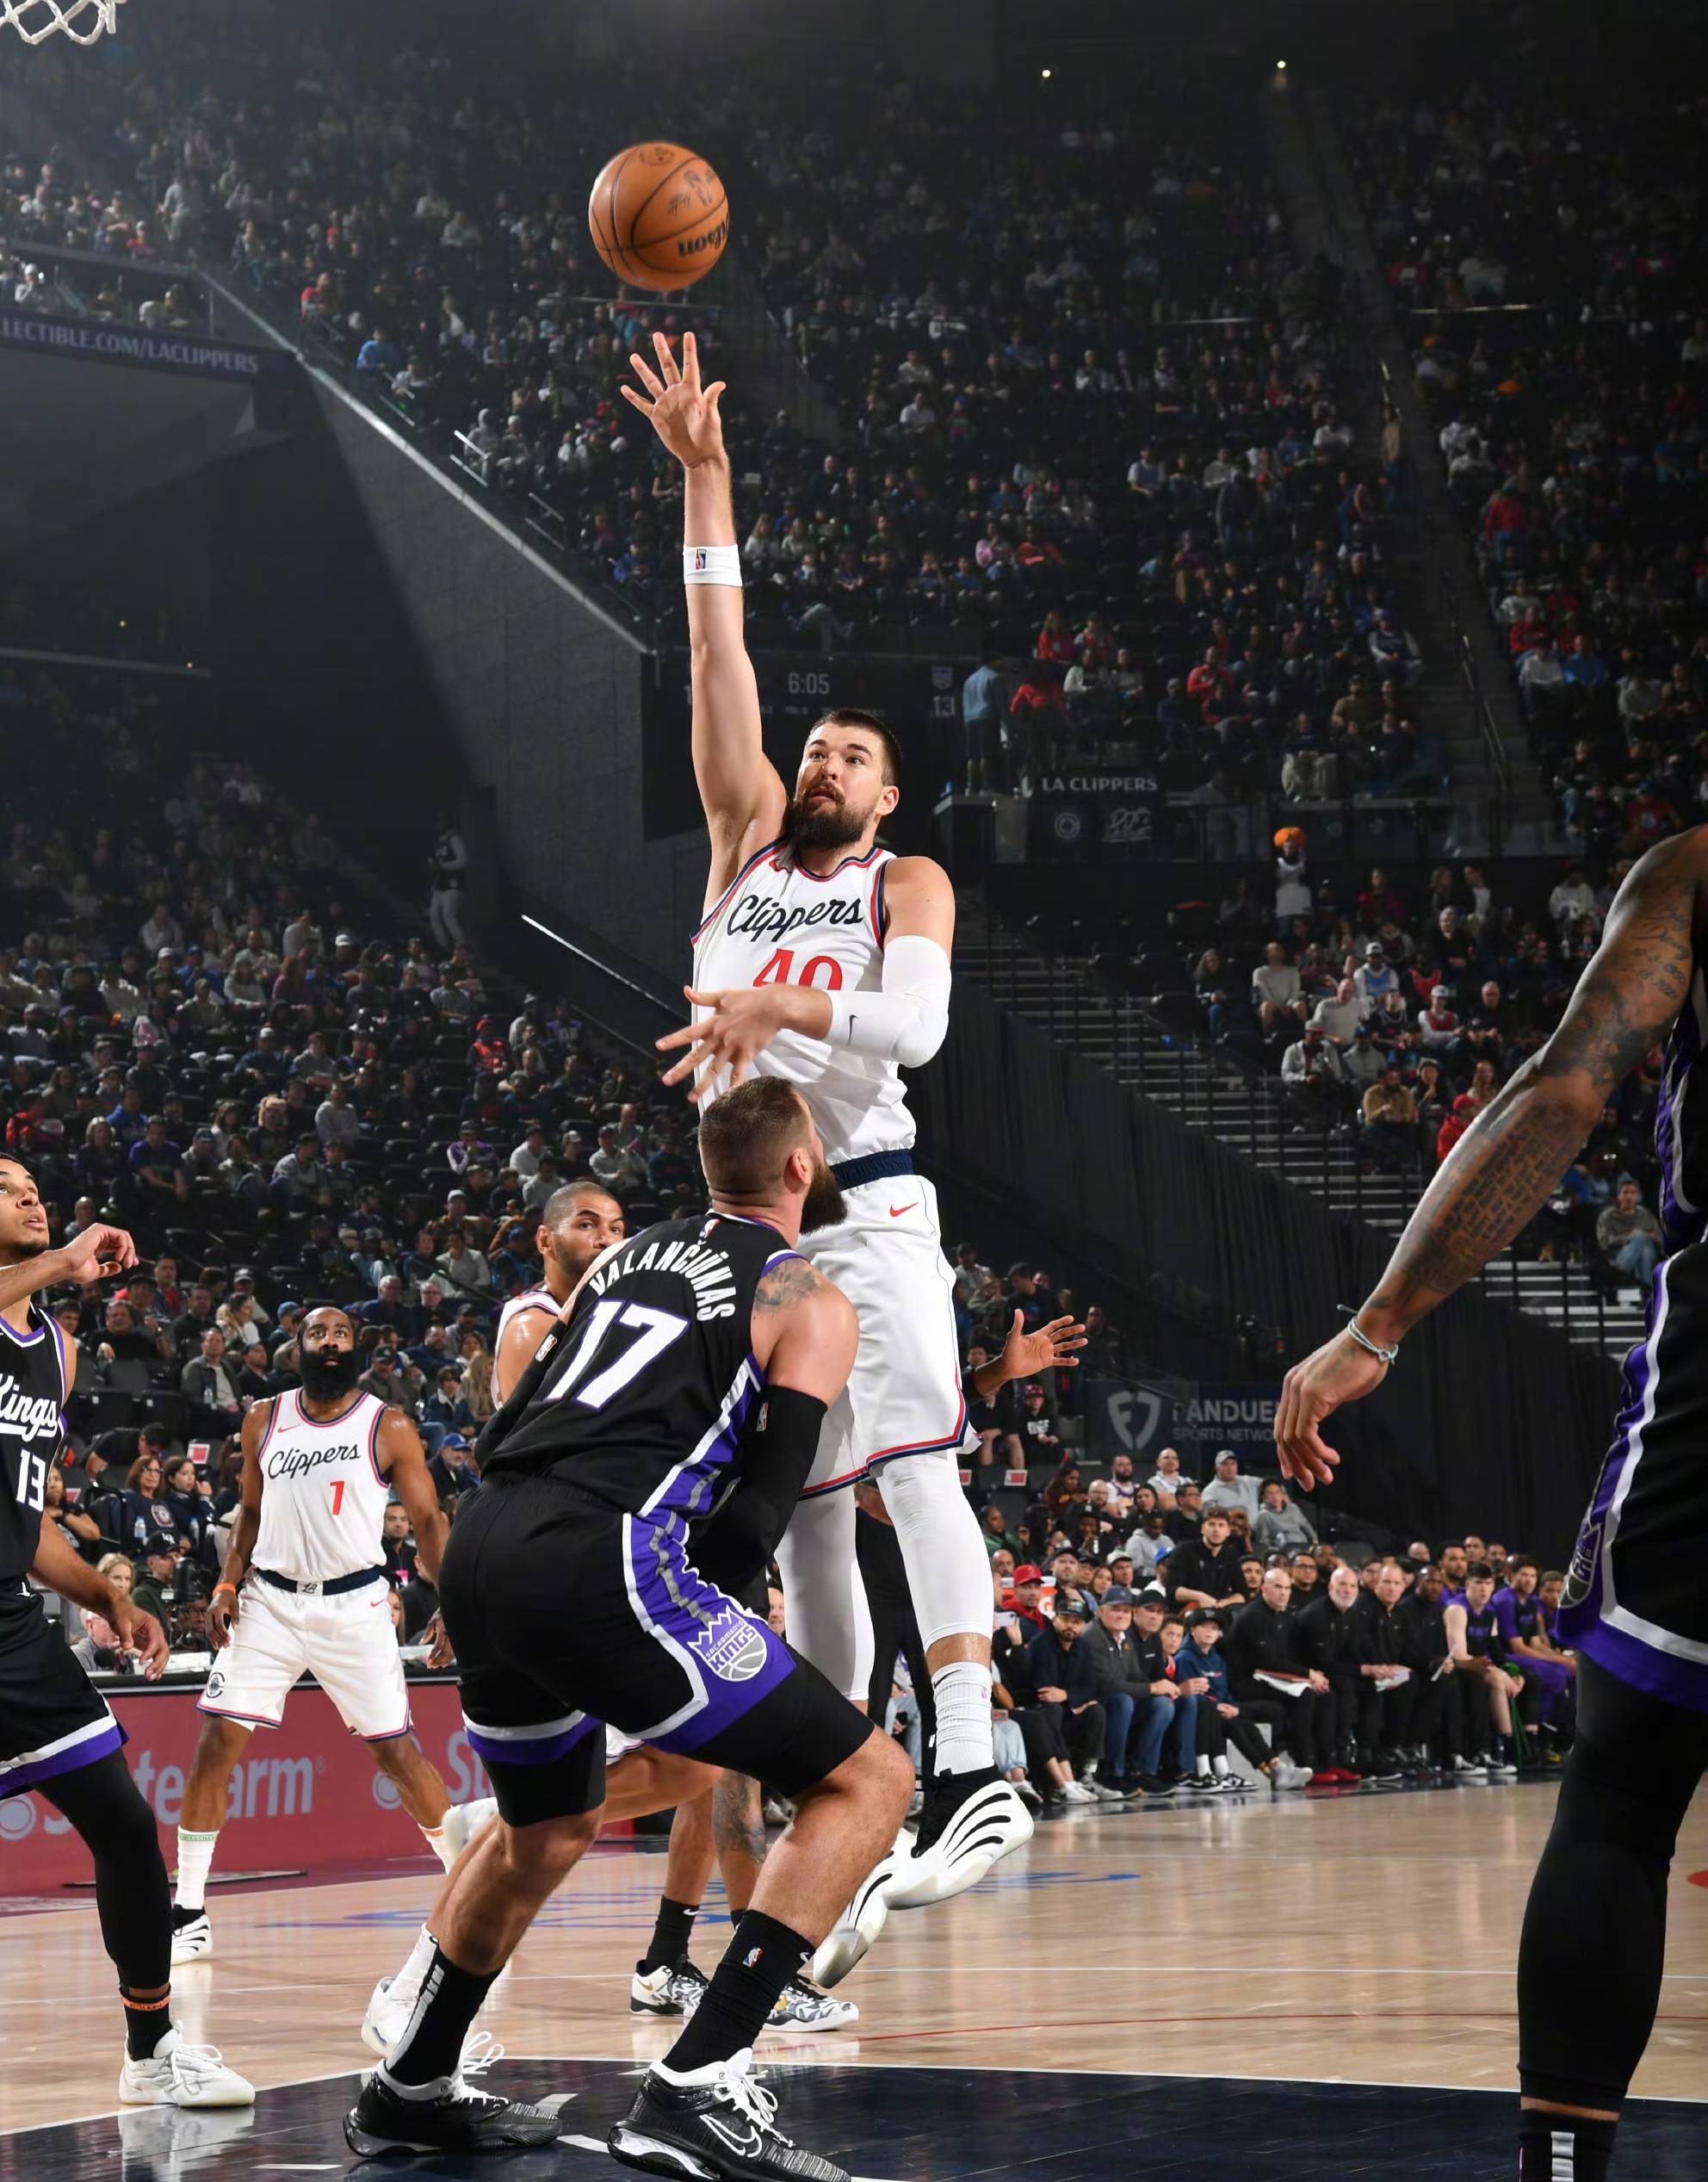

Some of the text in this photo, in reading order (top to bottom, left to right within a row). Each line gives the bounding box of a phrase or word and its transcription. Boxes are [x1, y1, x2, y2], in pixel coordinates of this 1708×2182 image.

[0, 319, 257, 373] LECTIBLE.COM/LACLIPPERS
[788, 672, 830, 695] 6:05
[1042, 777, 1158, 791] LA CLIPPERS
[727, 894, 865, 943] Clippers
[752, 948, 843, 991] 40
[589, 1240, 737, 1322] VALANČIŪNAS
[545, 1299, 691, 1410] 17
[15, 1448, 46, 1513] 13
[268, 1443, 361, 1479] Clippers
[330, 1480, 345, 1516] 1
[709, 1625, 757, 1671] KINGS
